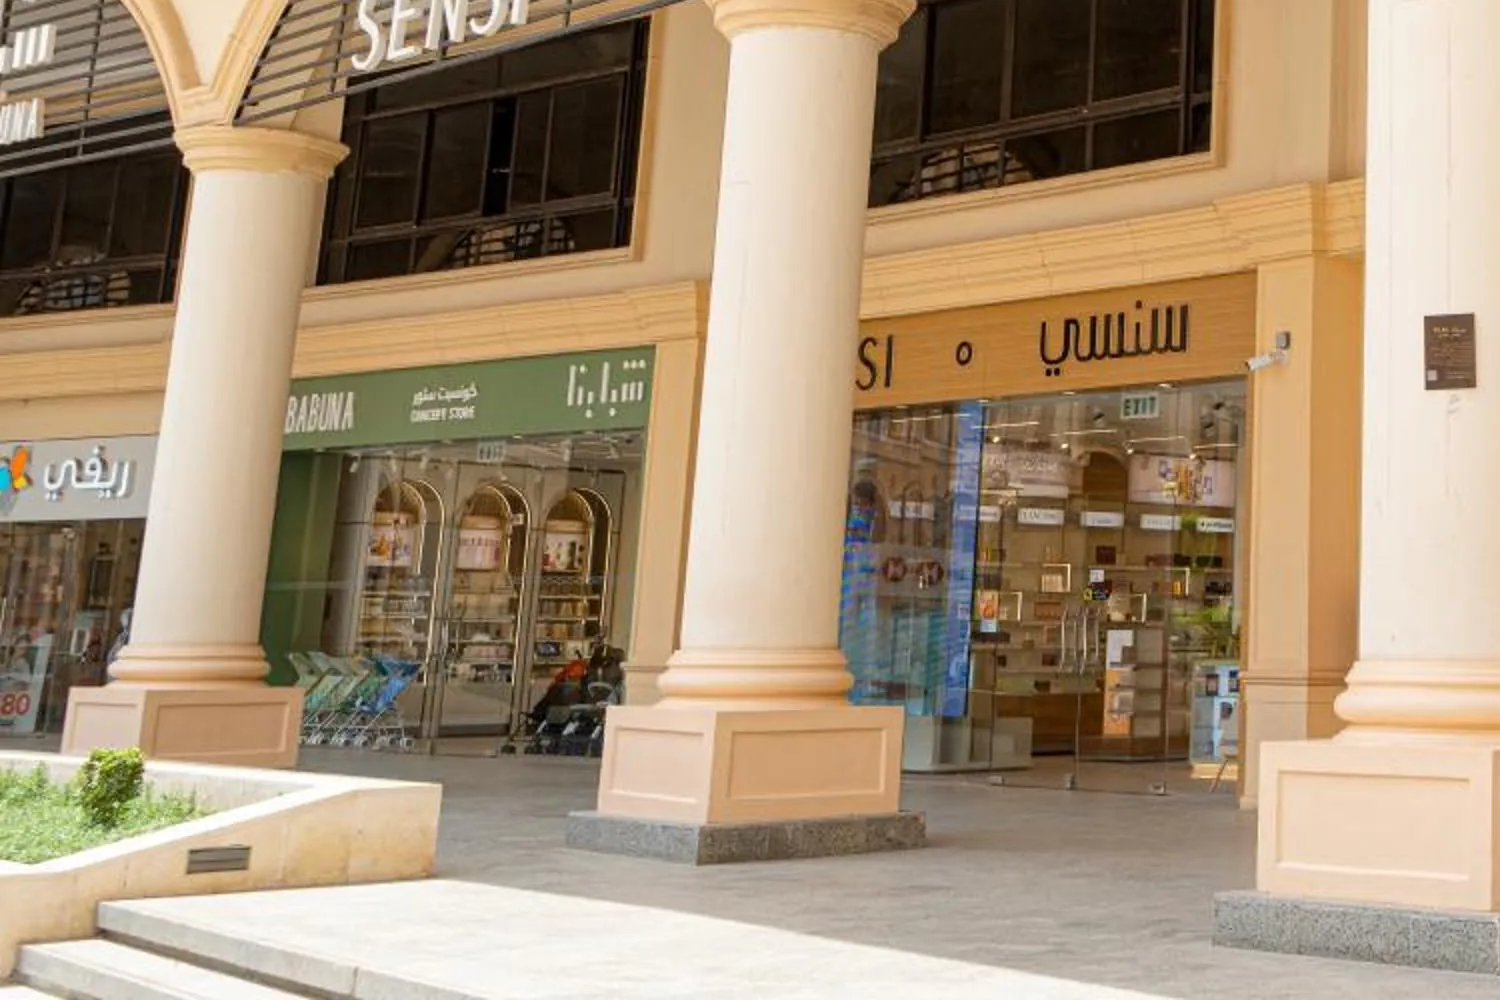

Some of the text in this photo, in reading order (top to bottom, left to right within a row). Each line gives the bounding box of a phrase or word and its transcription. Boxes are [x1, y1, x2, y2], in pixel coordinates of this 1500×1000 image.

[1039, 300, 1190, 376] سنسي
[448, 405, 475, 421] STORE
[1123, 397, 1156, 417] EXIT
[43, 444, 136, 500] ريفي
